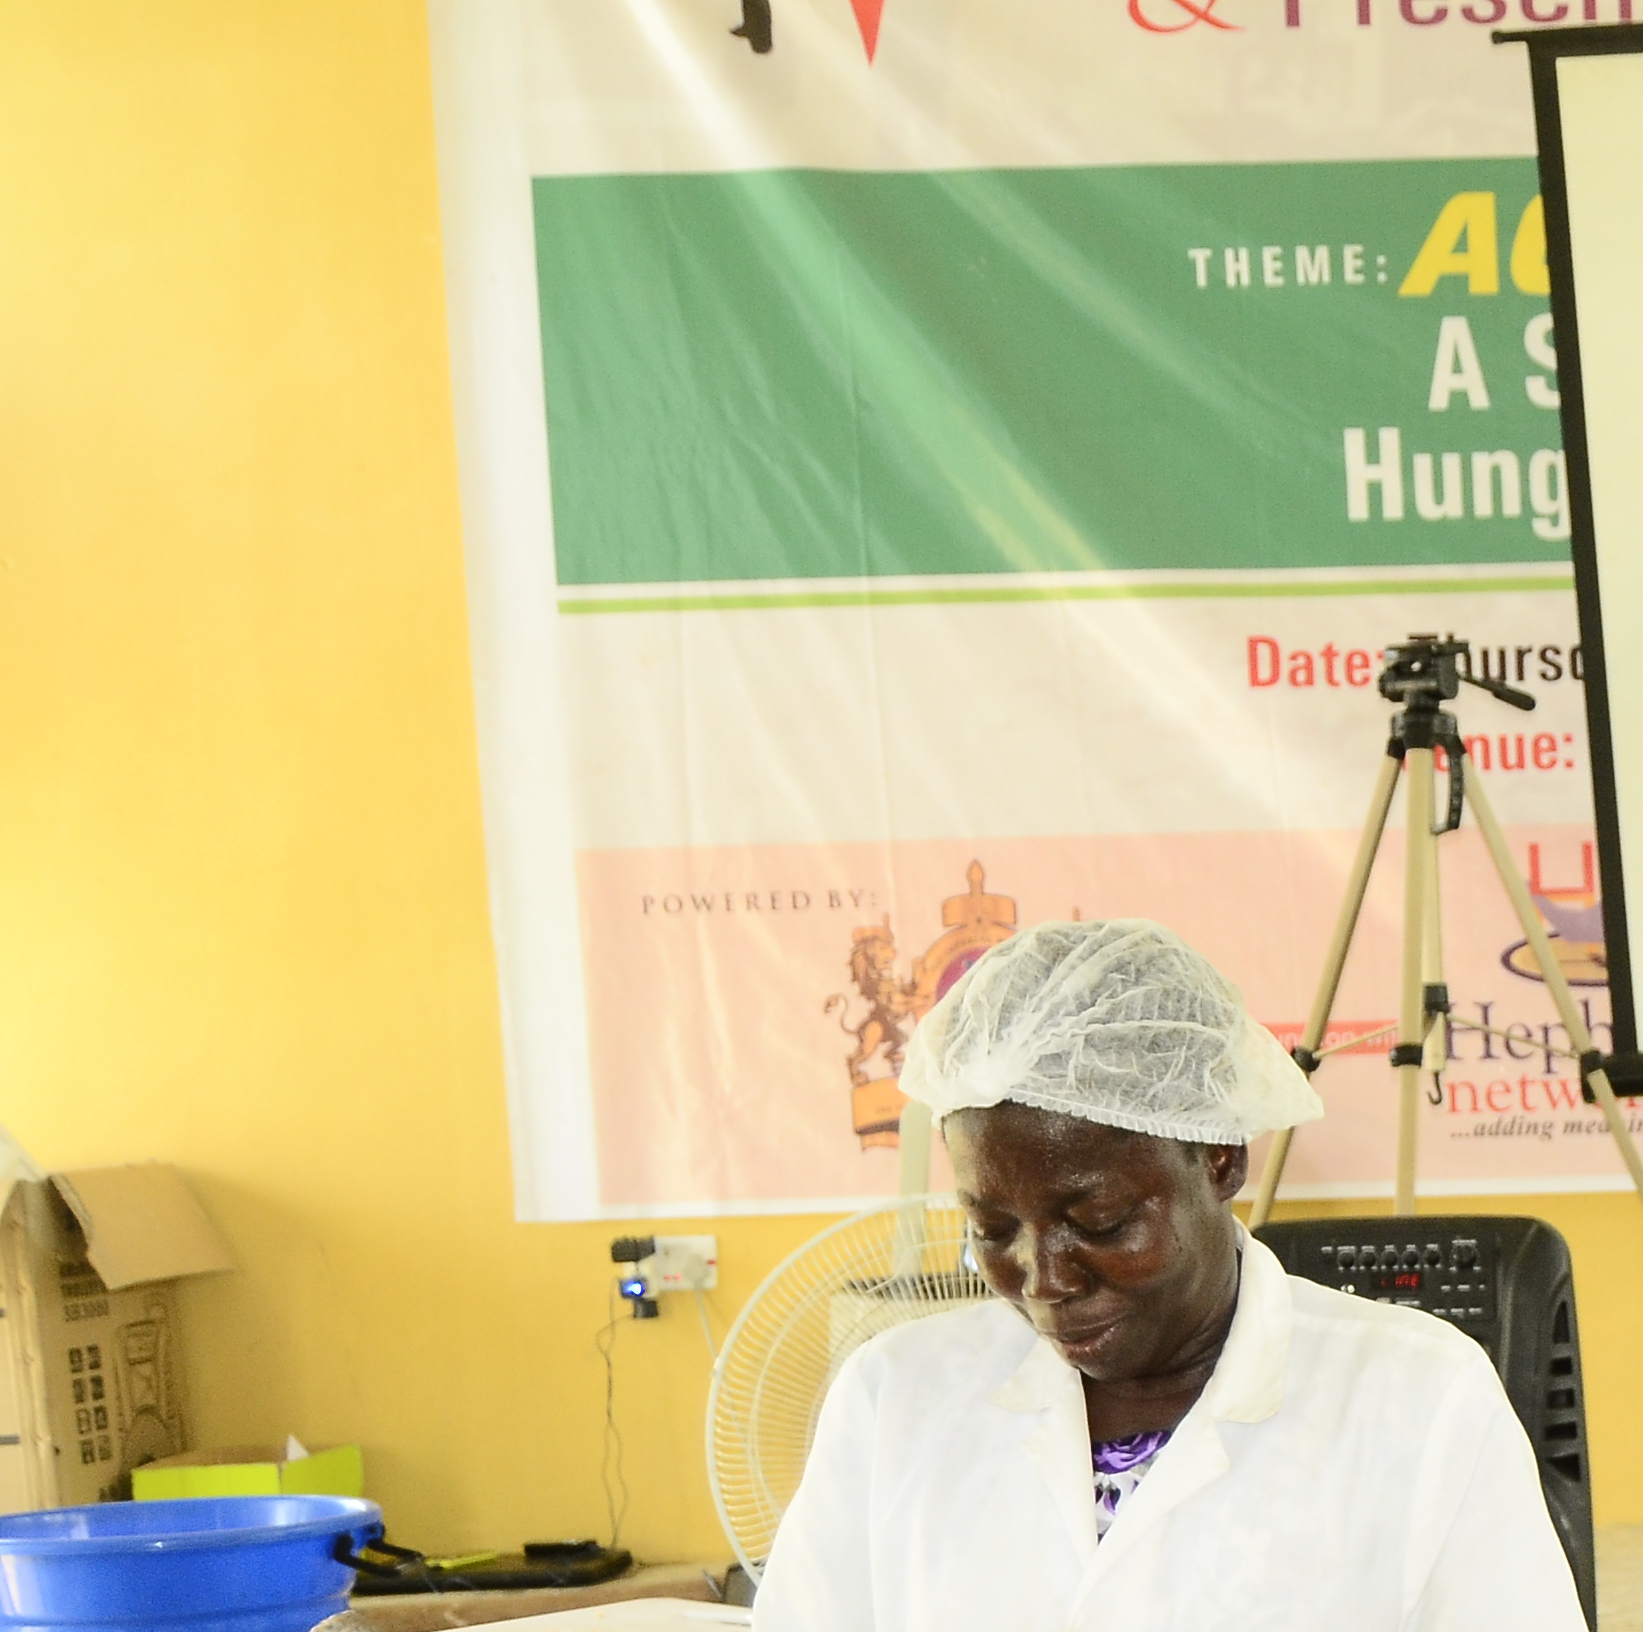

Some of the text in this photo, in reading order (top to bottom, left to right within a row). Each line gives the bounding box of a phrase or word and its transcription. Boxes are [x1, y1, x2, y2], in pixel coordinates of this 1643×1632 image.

[1188, 243, 1389, 289] THEME:
[1429, 315, 1491, 411] A
[1344, 426, 1572, 540] Hung
[641, 888, 879, 915] POWERED BY:
